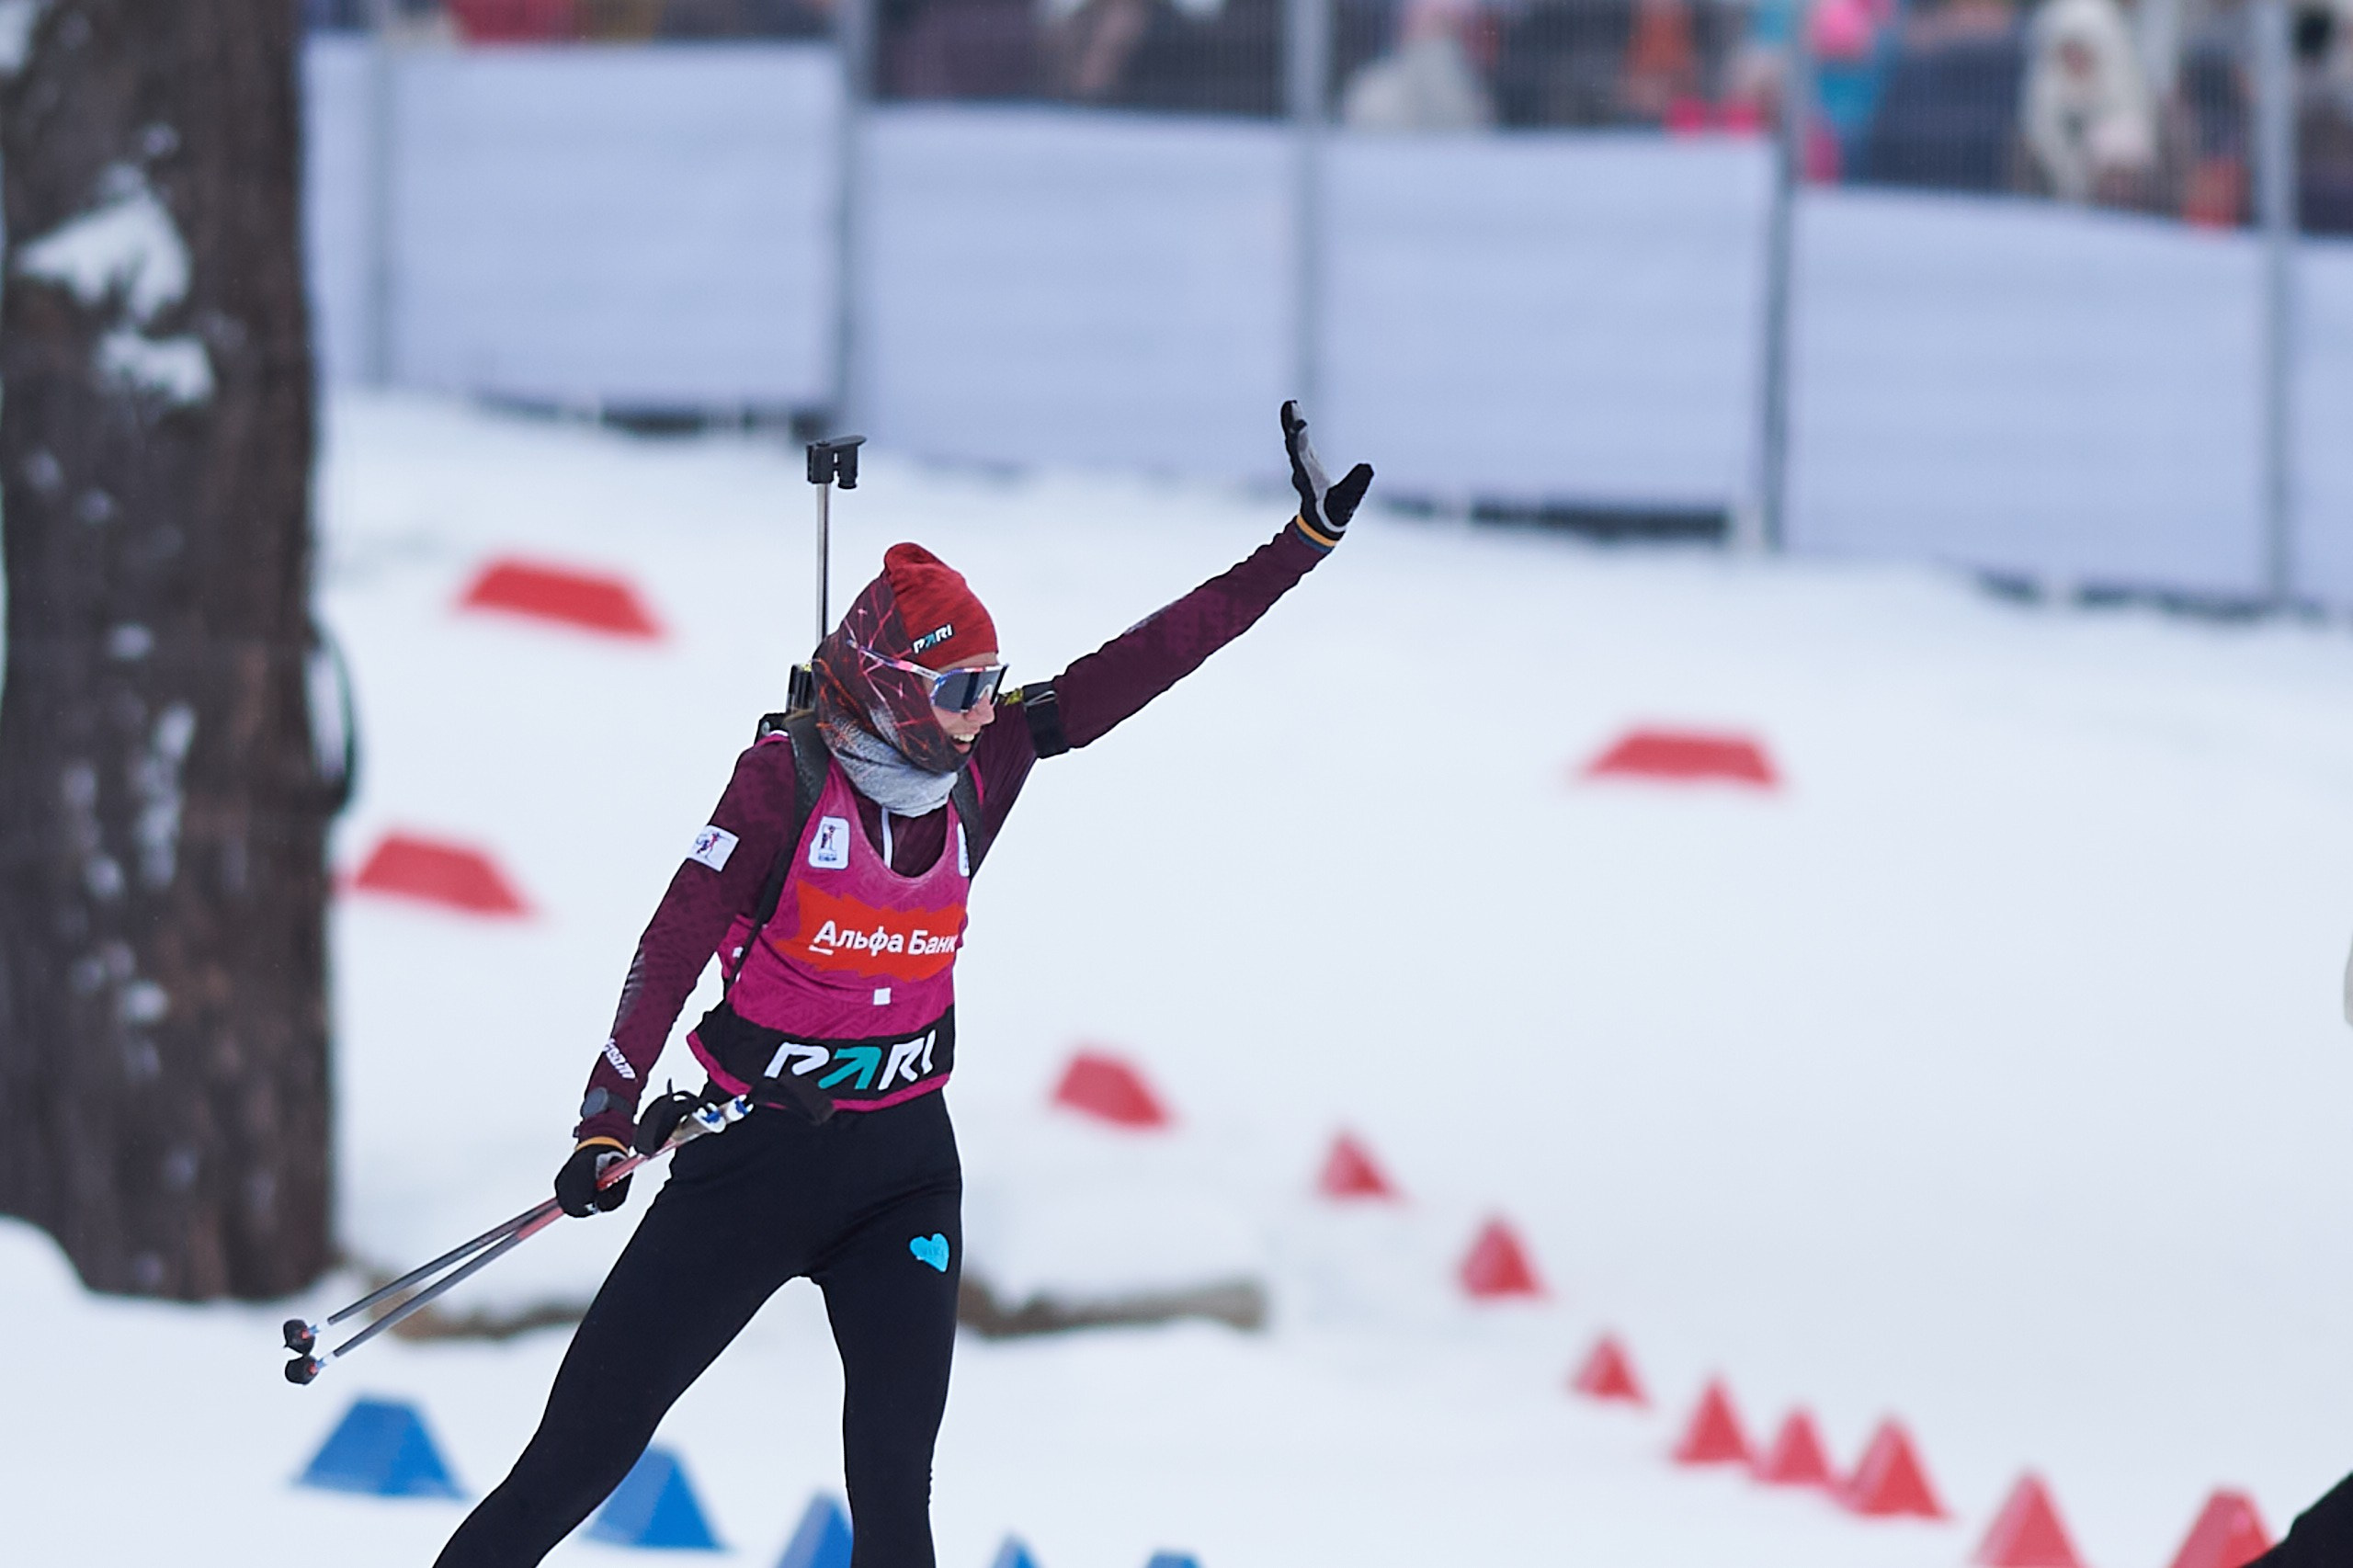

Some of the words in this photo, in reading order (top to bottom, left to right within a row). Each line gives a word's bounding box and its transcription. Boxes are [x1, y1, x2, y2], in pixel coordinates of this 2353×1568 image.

[913, 623, 953, 654] PARI
[811, 920, 904, 957] Альфа
[907, 929, 959, 956] Банк
[764, 1029, 937, 1091] PARI
